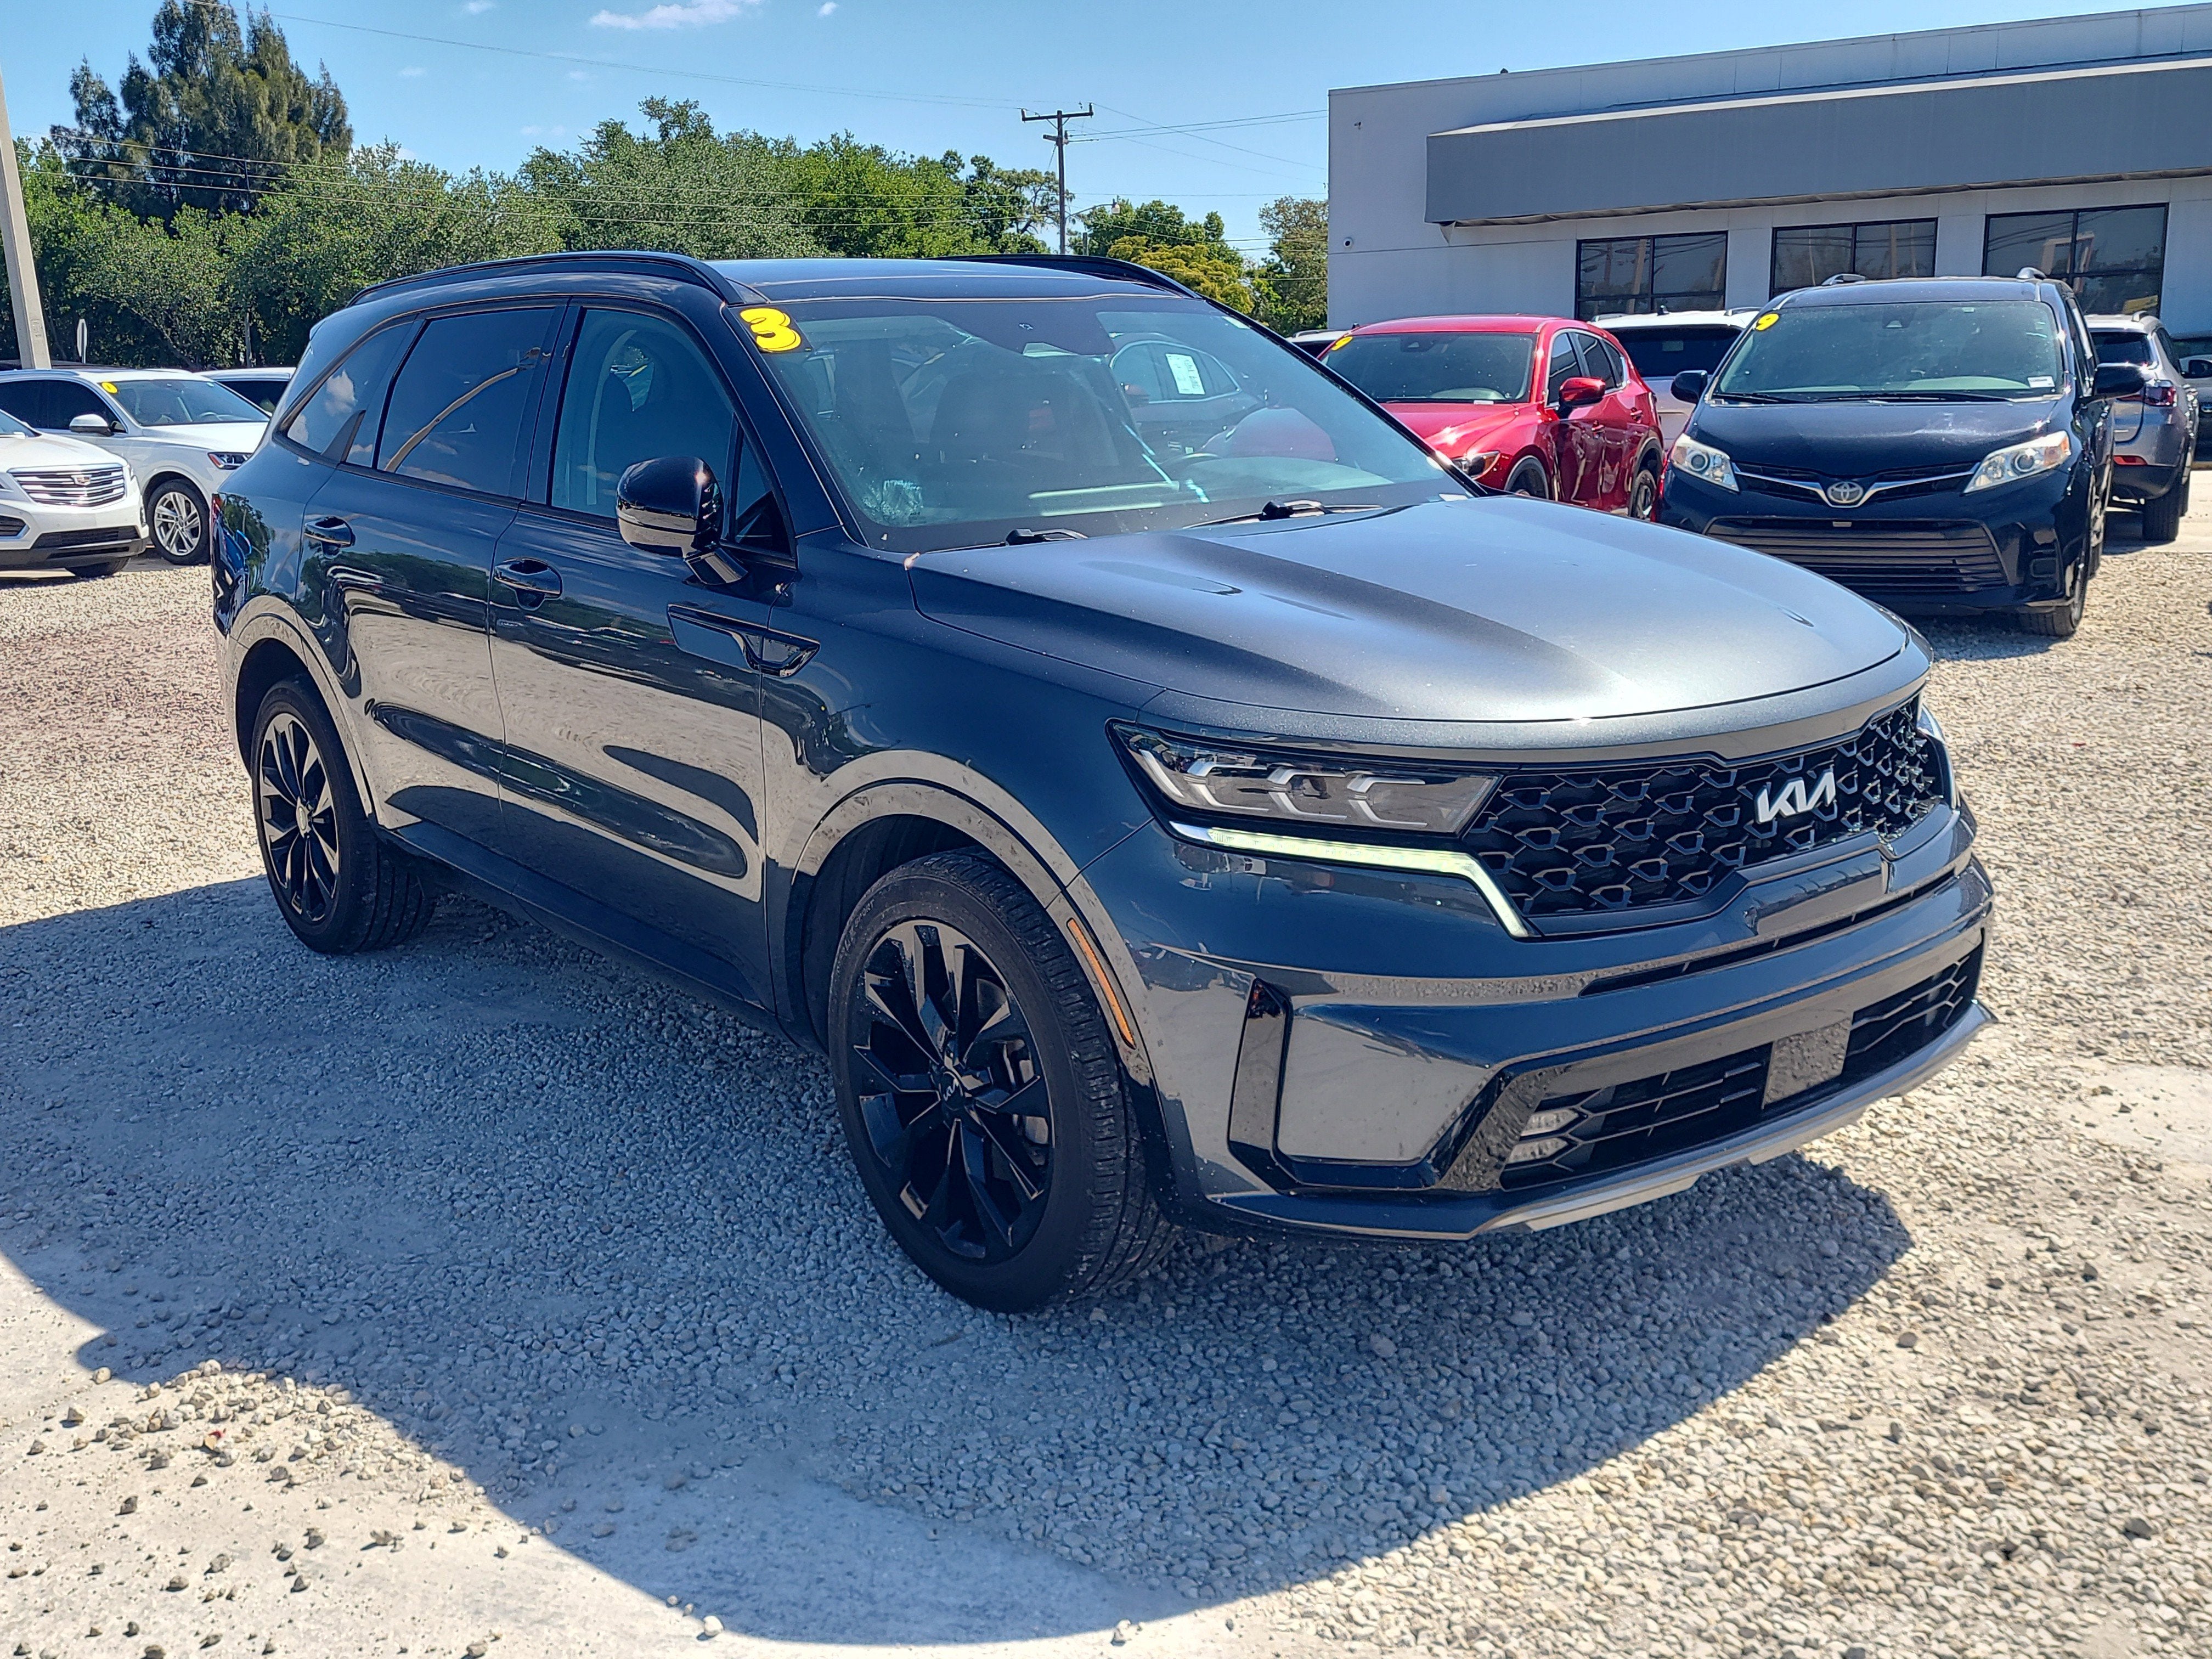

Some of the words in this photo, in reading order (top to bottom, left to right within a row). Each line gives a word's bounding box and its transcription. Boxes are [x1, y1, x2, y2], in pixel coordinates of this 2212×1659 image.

[740, 308, 802, 352] 3
[1756, 313, 1780, 331] 9
[1756, 769, 1837, 824] KIA
